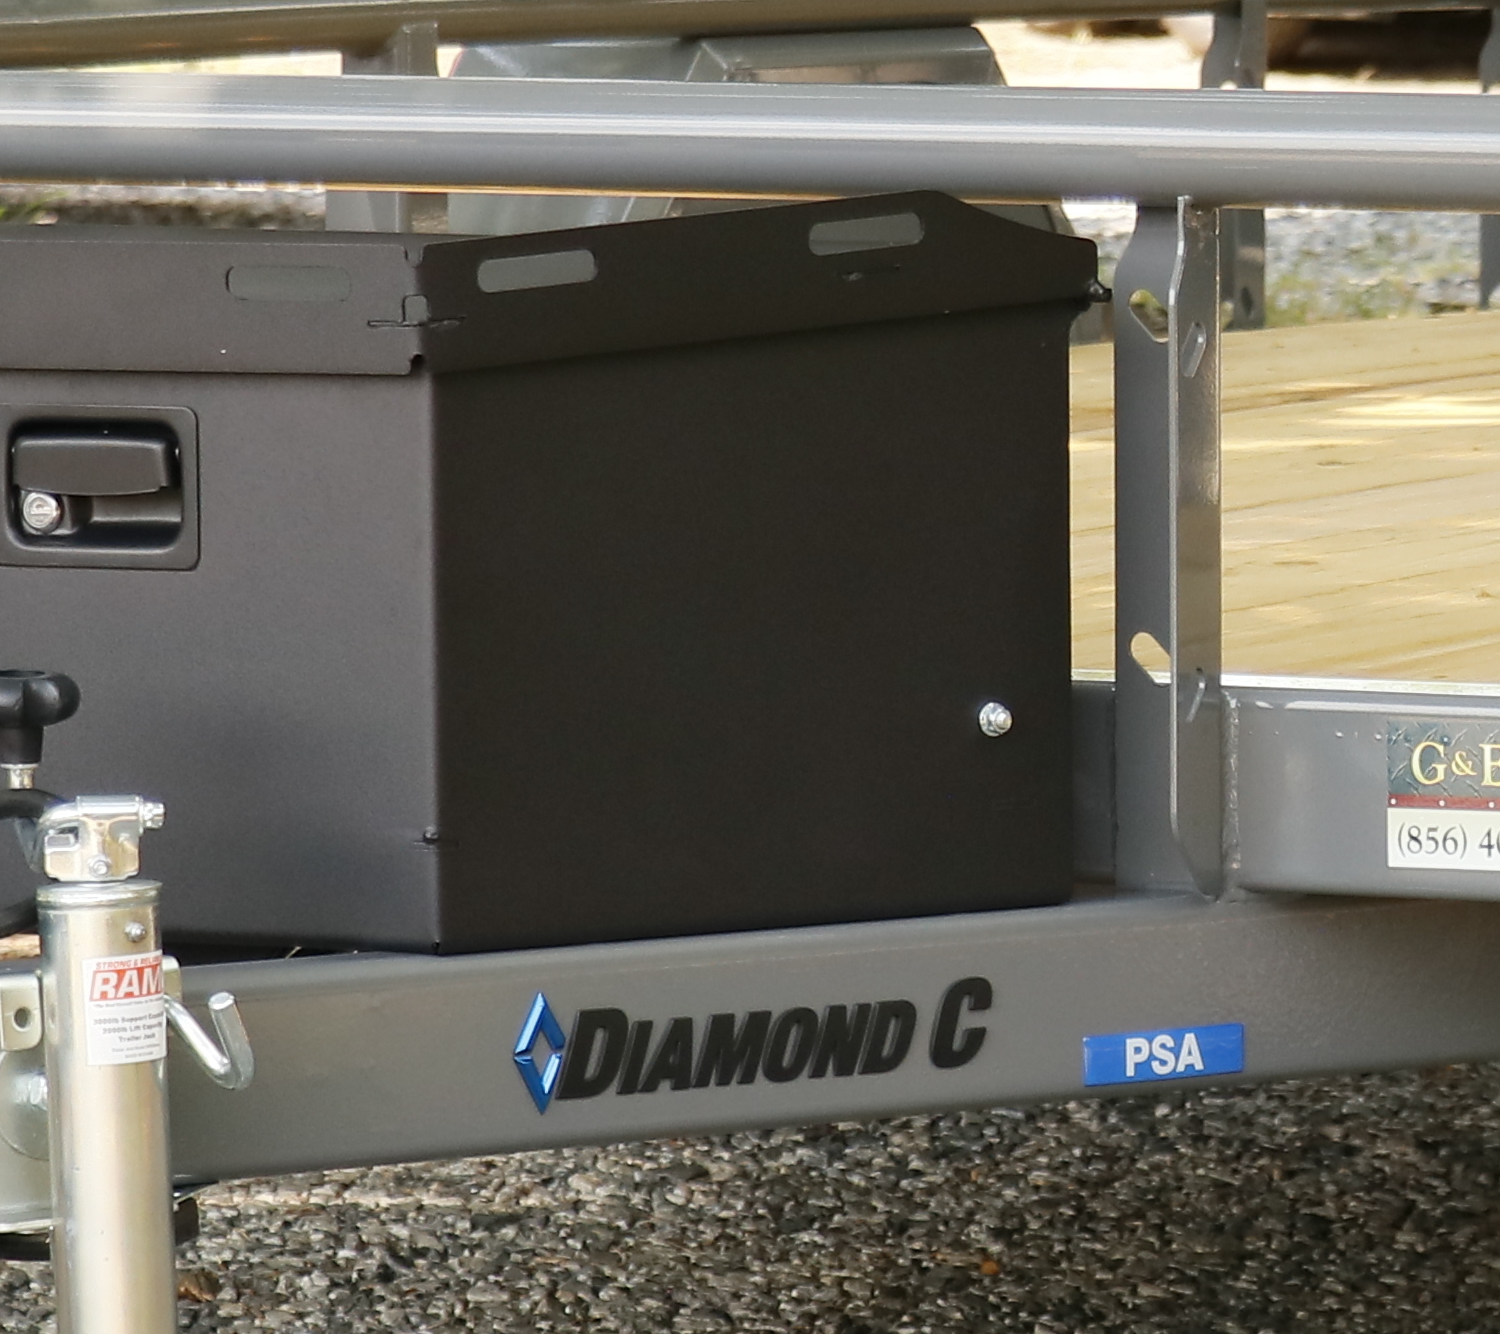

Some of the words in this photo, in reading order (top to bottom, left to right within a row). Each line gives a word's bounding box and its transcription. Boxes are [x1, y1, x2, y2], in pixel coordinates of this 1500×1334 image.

[1397, 822, 1467, 859] (856)
[92, 965, 163, 999] RAM
[555, 999, 917, 1101] DIAMOND
[929, 975, 993, 1069] C
[1125, 1032, 1205, 1077] PSA
